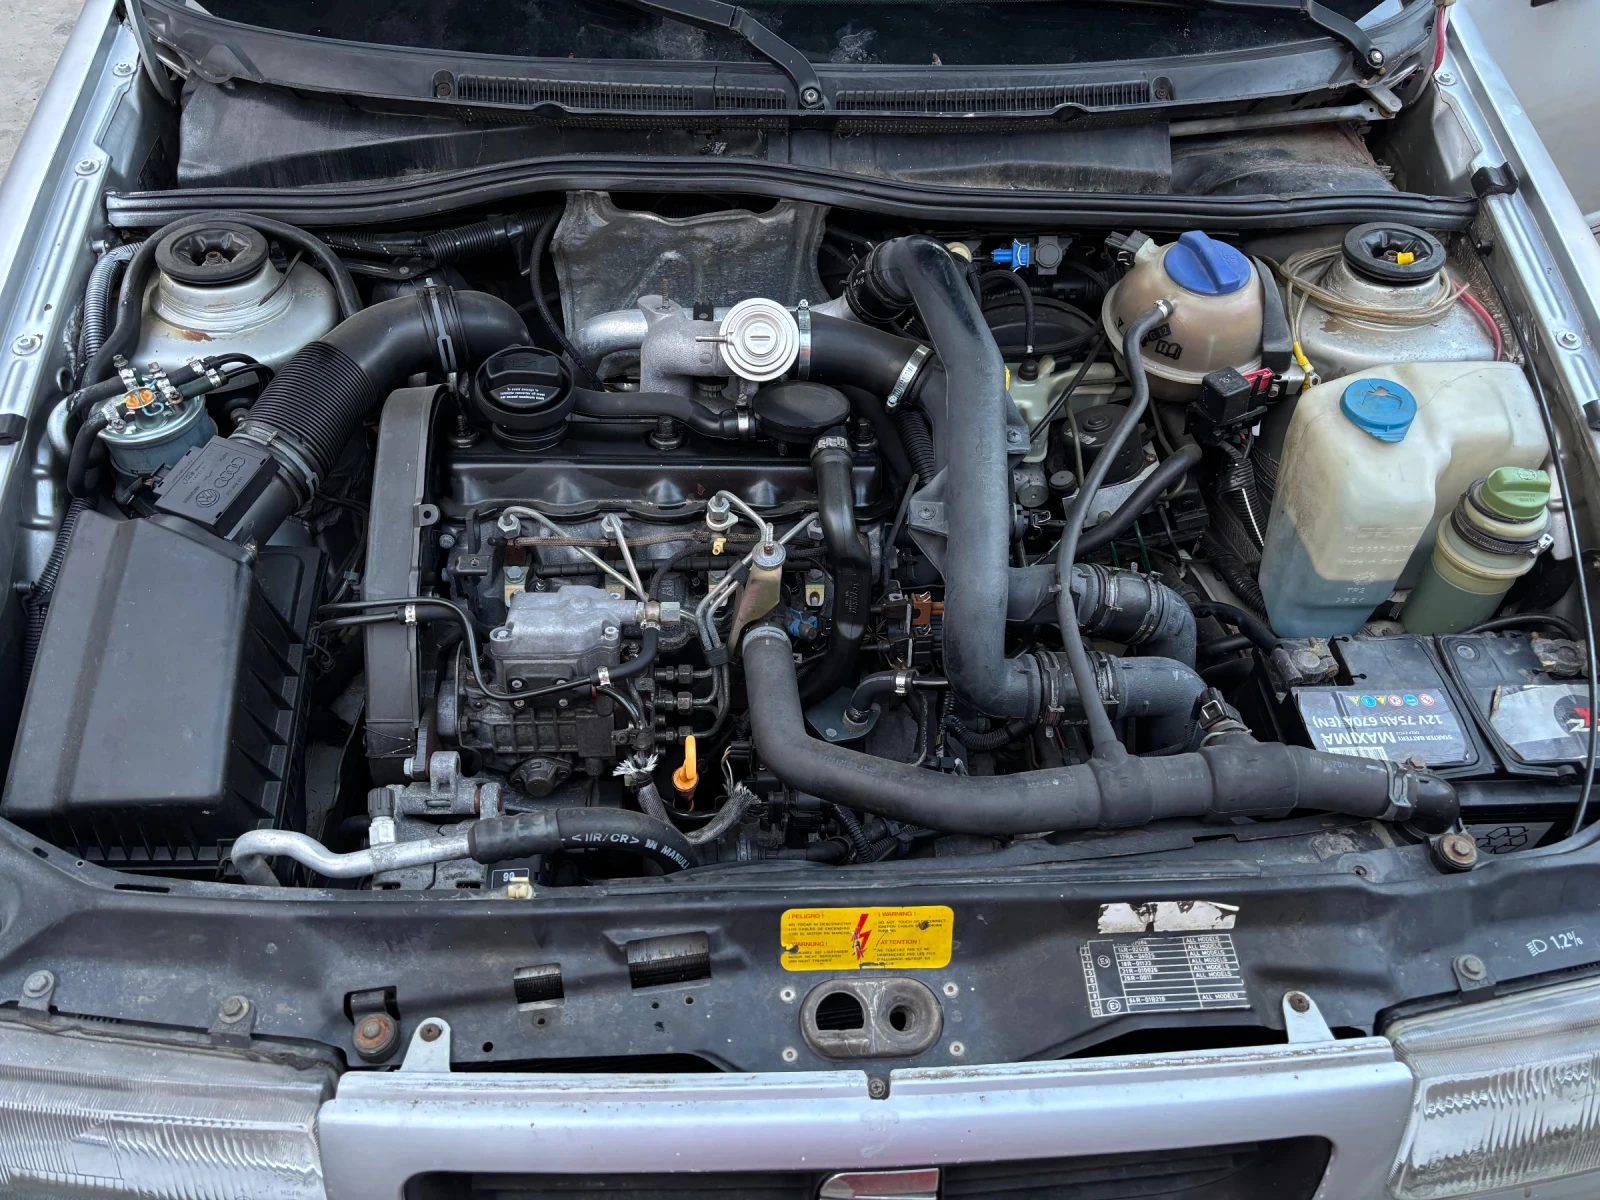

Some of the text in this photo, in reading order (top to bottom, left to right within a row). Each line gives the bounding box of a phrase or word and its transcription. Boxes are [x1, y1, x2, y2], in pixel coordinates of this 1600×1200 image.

[1312, 714, 1444, 728] 12V 75Ah 670A (EN)
[1320, 732, 1397, 745] MAXIMA
[660, 845, 690, 870] MANULI
[502, 872, 515, 882] 90
